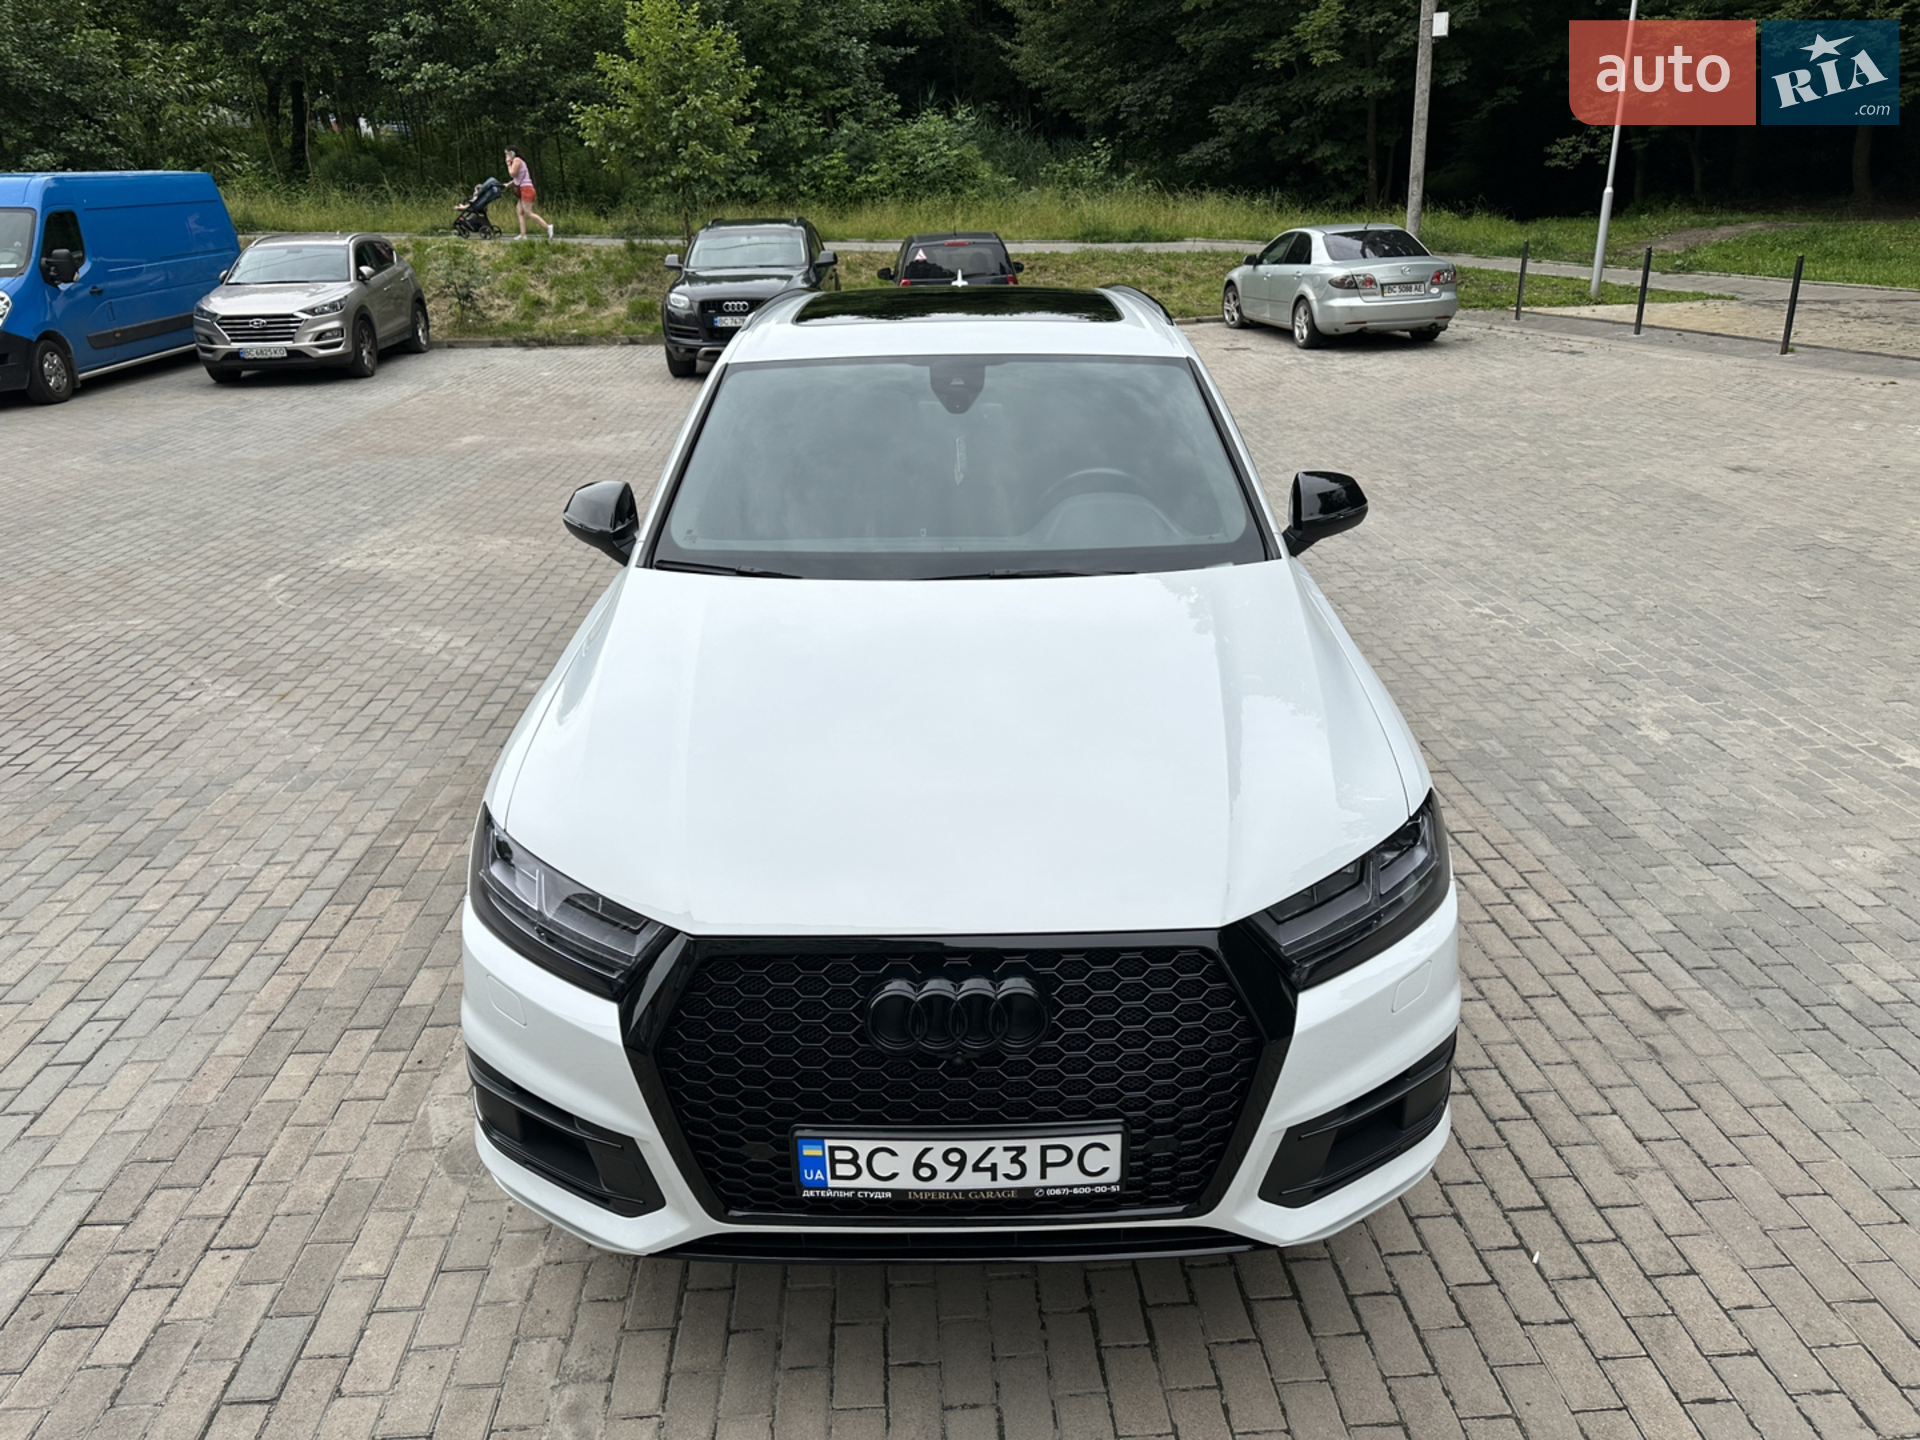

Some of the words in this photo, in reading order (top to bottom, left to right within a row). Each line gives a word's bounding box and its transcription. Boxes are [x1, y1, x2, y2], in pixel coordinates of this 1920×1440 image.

[828, 1145, 900, 1182] BC
[911, 1146, 1028, 1183] 6943
[1039, 1142, 1111, 1180] PC
[804, 1169, 825, 1181] UA
[802, 1189, 855, 1198] ДЕТЕЙЛІНГ
[857, 1190, 892, 1199] СТУДІЯ
[908, 1190, 966, 1200] IMPERIAL
[968, 1189, 1019, 1200] GARAGE
